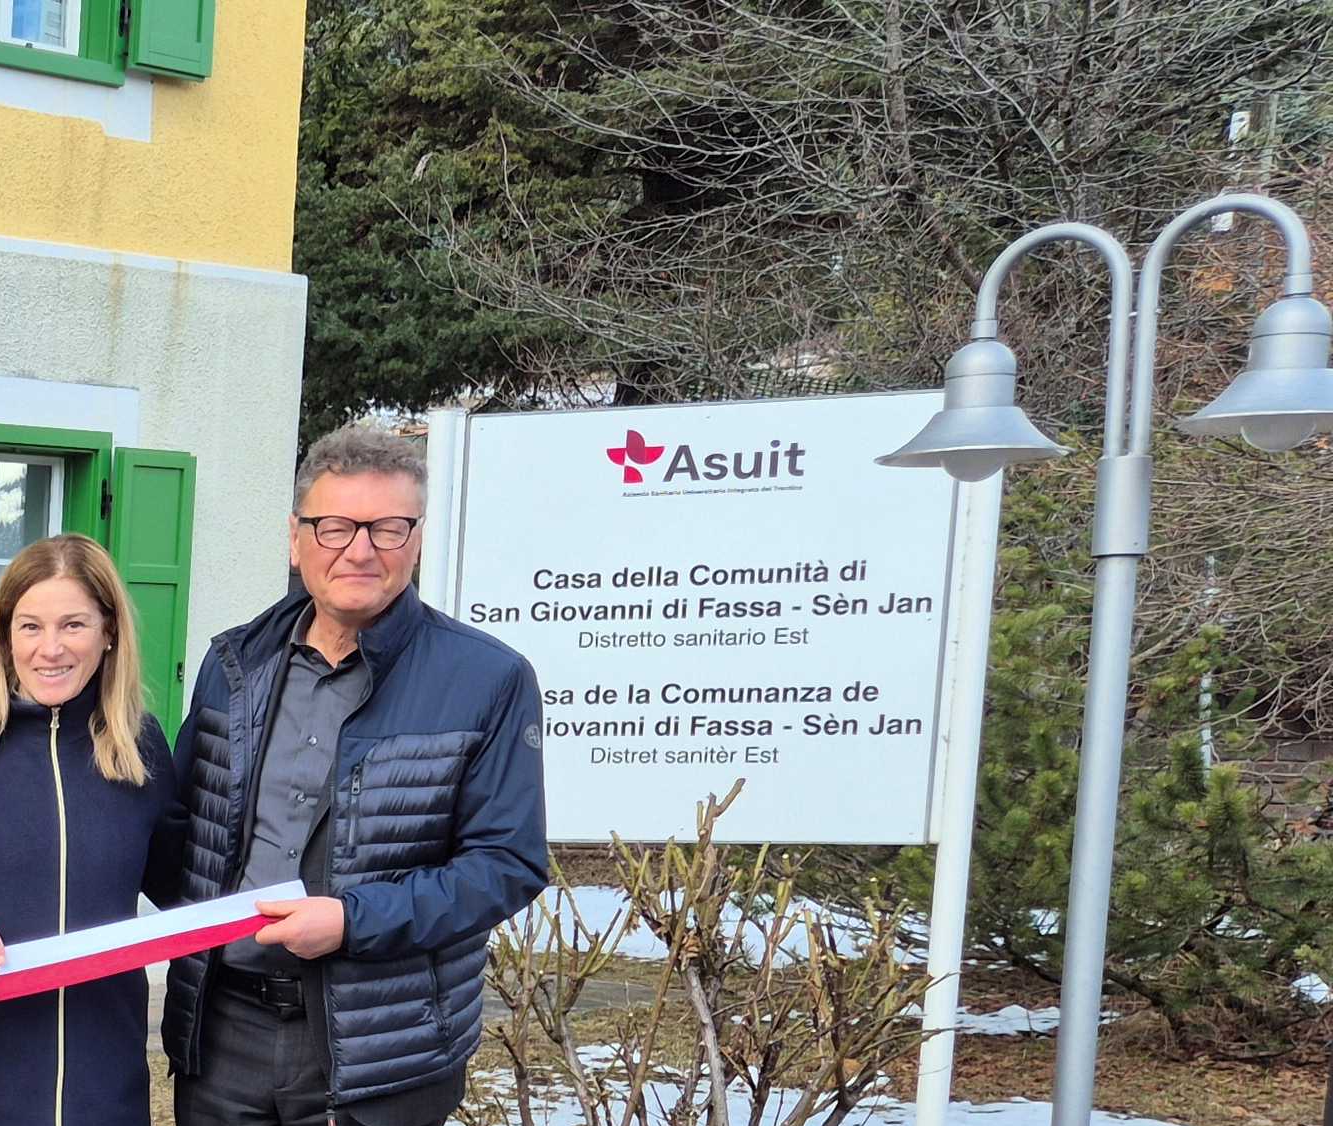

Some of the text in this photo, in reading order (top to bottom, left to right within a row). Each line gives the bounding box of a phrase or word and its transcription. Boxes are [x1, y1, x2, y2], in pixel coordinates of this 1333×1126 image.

[662, 439, 806, 483] Asuit
[533, 559, 867, 591] Casa della Comunità di
[469, 603, 520, 623] San
[530, 598, 653, 622] Giovanni
[662, 597, 688, 620] di
[698, 597, 782, 619] Fassa
[811, 592, 868, 616] Sèn
[878, 591, 933, 615] Jan
[578, 627, 809, 649] Distretto sanitario Est
[543, 680, 879, 705] sa de la Comunanza de
[545, 715, 645, 738] iovanni
[654, 715, 680, 737] di
[690, 714, 773, 737] Fassa
[802, 712, 858, 736] Sèn
[868, 711, 923, 736] Jan
[590, 744, 779, 764] Distret sanitèr Est
